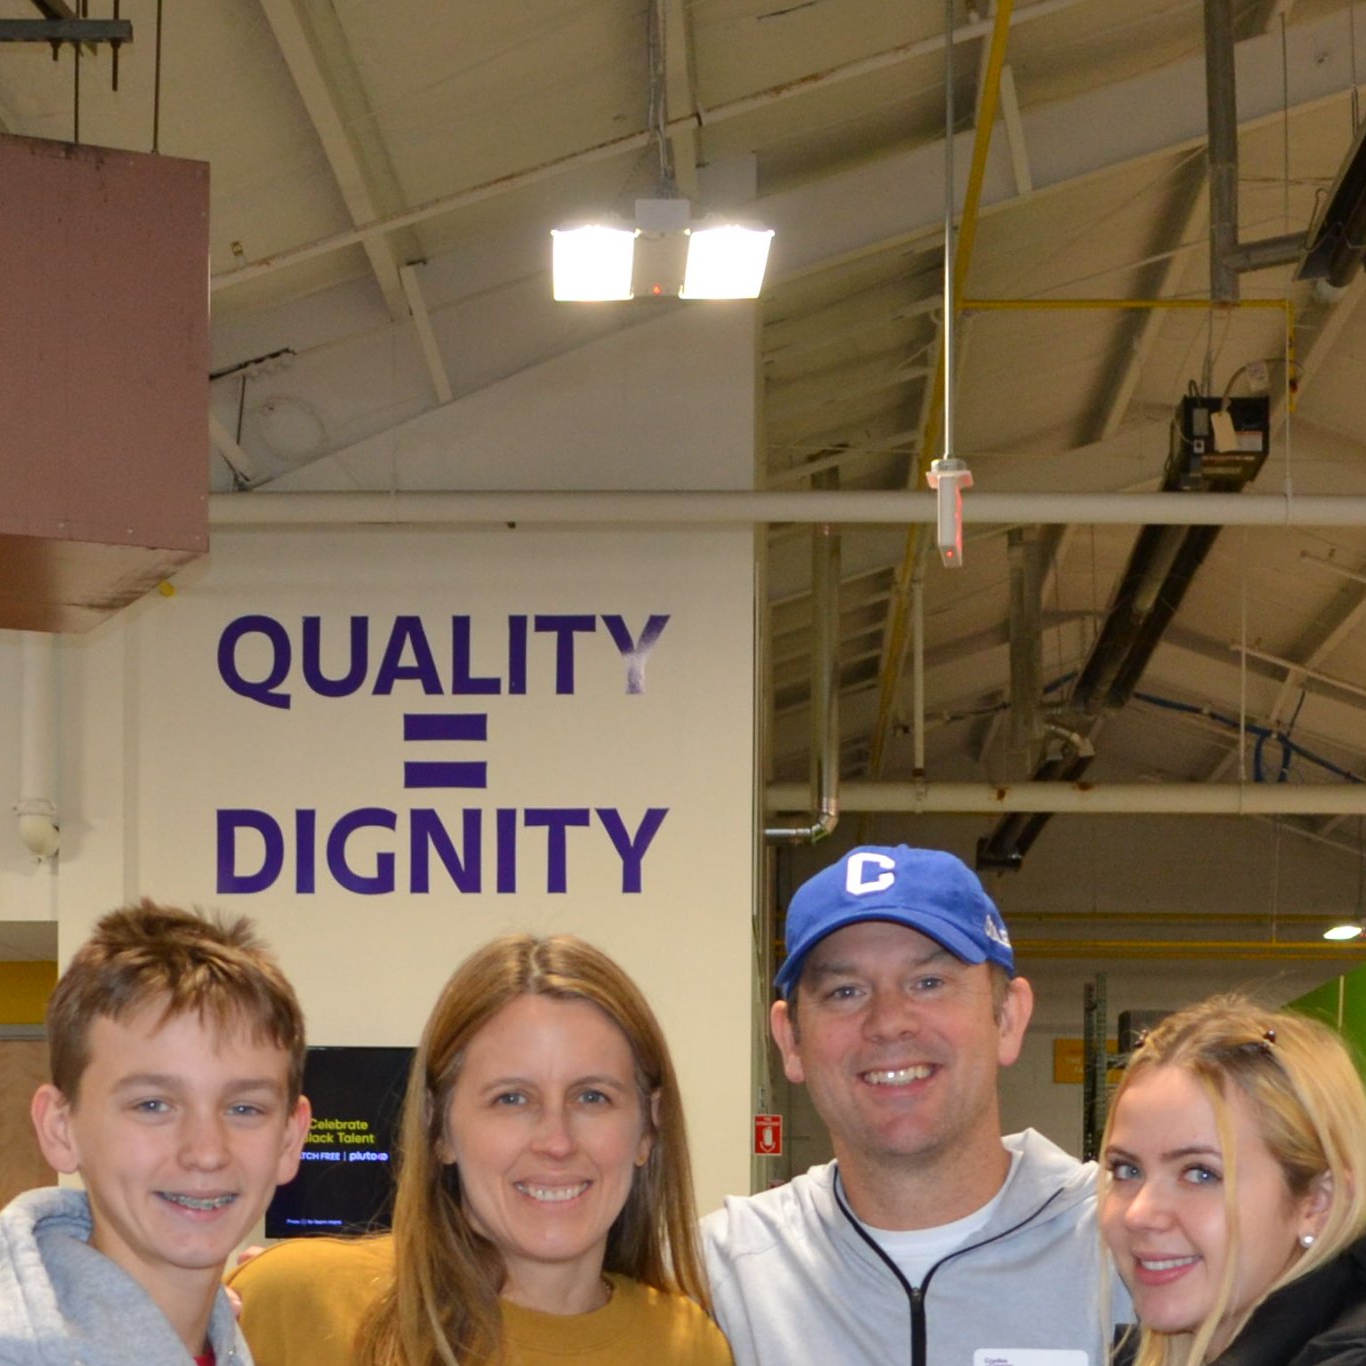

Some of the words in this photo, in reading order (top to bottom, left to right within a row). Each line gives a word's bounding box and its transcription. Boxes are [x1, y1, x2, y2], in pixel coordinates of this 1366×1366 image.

[217, 613, 672, 710] QUALITY
[216, 807, 671, 896] DIGNITY
[845, 852, 896, 896] C
[309, 1118, 368, 1131] Celebrate
[337, 1132, 375, 1145] Talent
